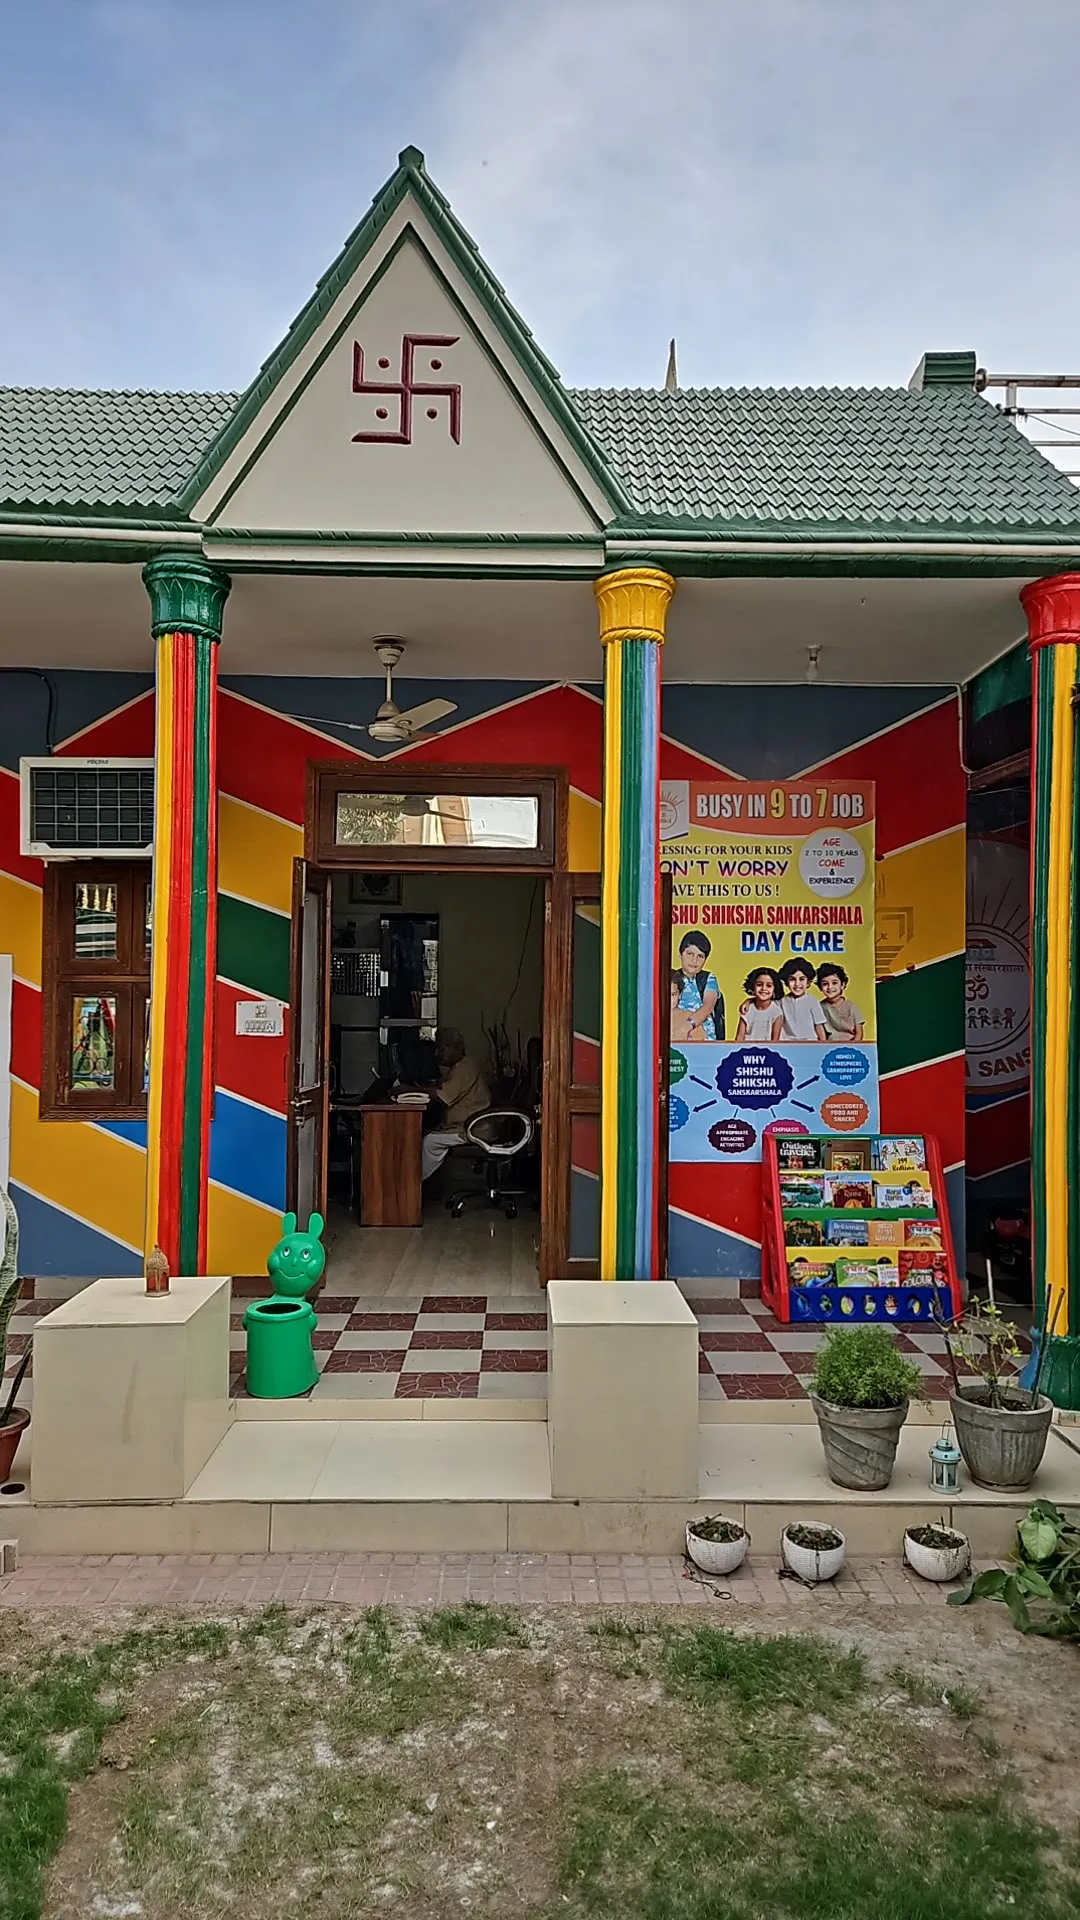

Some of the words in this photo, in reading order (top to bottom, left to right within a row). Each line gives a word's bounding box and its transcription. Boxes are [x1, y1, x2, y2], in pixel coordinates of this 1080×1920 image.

[696, 794, 743, 818] BUSY
[748, 794, 766, 818] IN
[770, 788, 785, 818] 9
[789, 794, 812, 818] TO
[815, 788, 828, 818] 7
[831, 794, 864, 818] JOB
[822, 838, 841, 847] AGE
[705, 845, 727, 855] FOR
[729, 845, 762, 855] YOUR
[765, 845, 793, 855] KIDS
[717, 860, 789, 876] WORRY
[818, 859, 846, 867] COME
[828, 868, 836, 876] &
[809, 877, 855, 885] EXPERIENCE
[697, 884, 729, 896] THIS
[731, 884, 751, 897] TO
[755, 884, 772, 896] US
[702, 905, 763, 925] SHIKSHA
[767, 906, 863, 925] SANKARSHALA
[741, 931, 784, 952] DAY
[791, 931, 844, 952] CARE
[743, 1055, 766, 1065] WHY
[736, 1067, 773, 1076] SHISHU
[732, 1078, 777, 1088] SHIKSHA
[782, 1142, 814, 1150] Outlook
